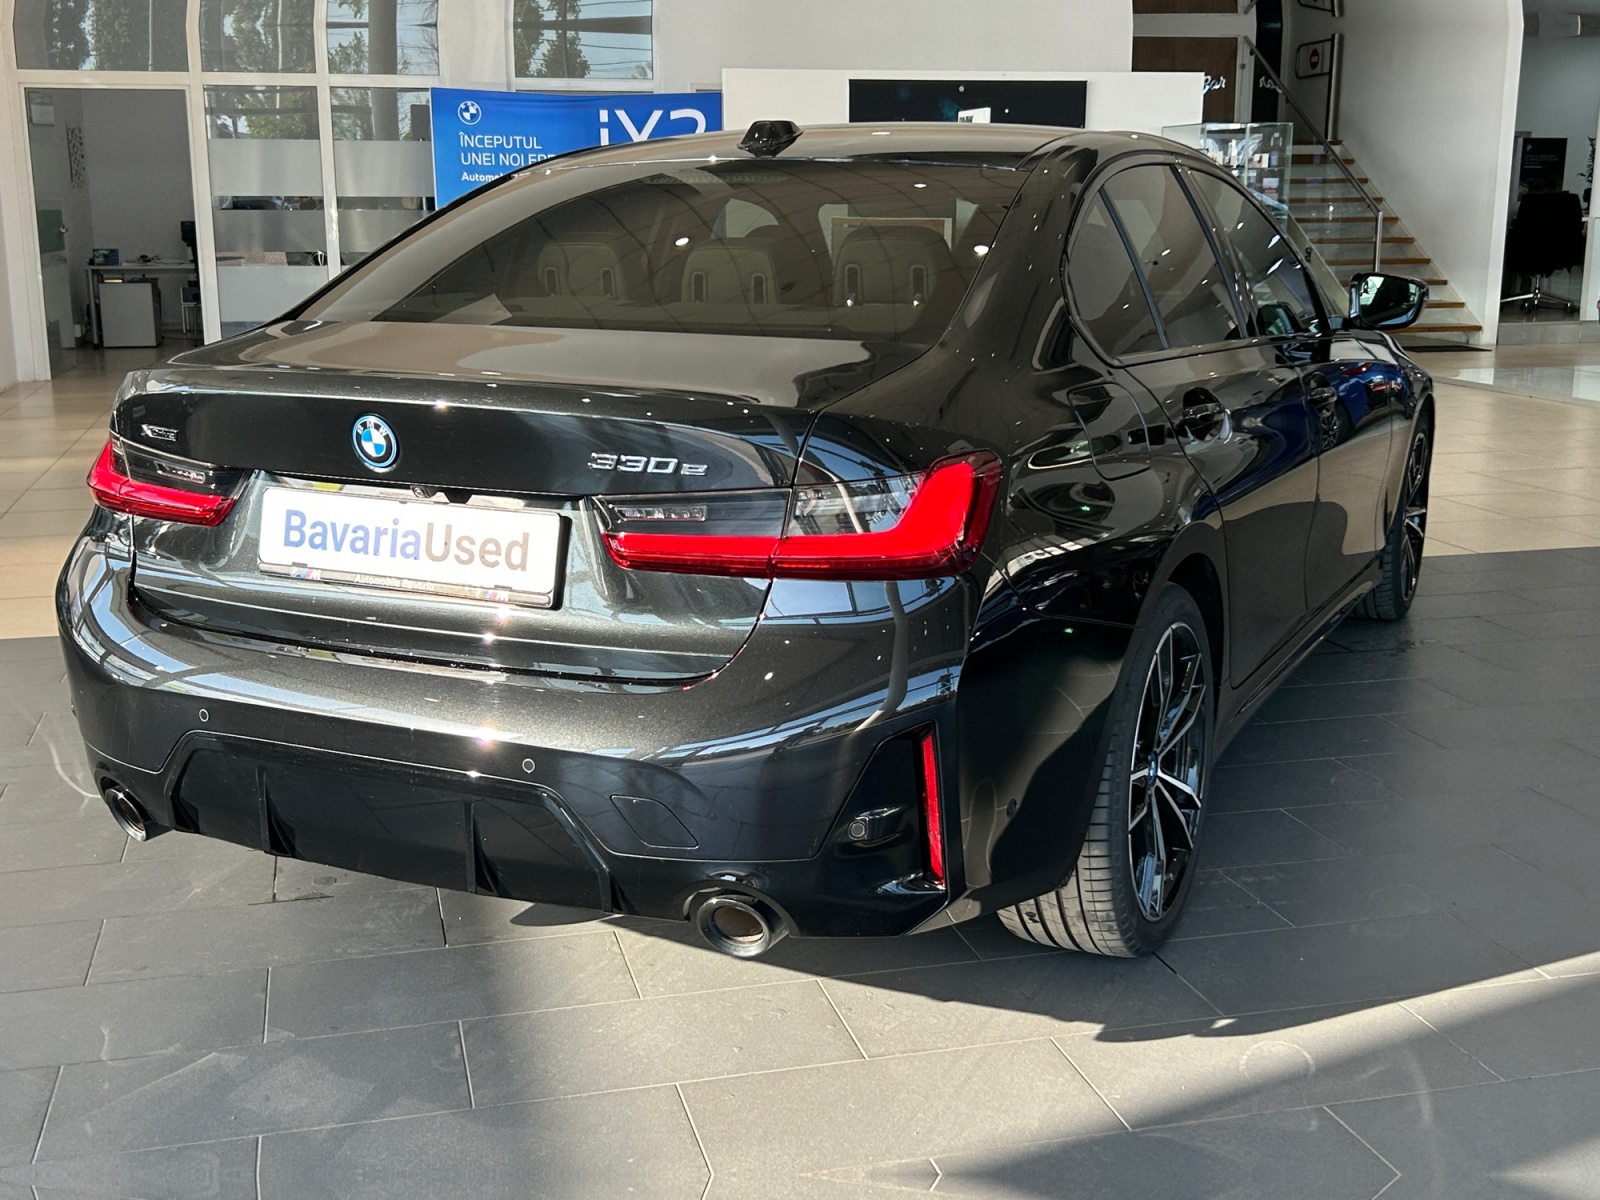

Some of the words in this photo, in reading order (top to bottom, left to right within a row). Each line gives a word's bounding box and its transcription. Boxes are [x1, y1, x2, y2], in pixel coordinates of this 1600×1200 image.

[459, 131, 542, 149] ÎNCEPUTUL
[461, 152, 495, 166] UNEI
[499, 153, 525, 167] NOI
[283, 509, 530, 572] BavariaUsed
